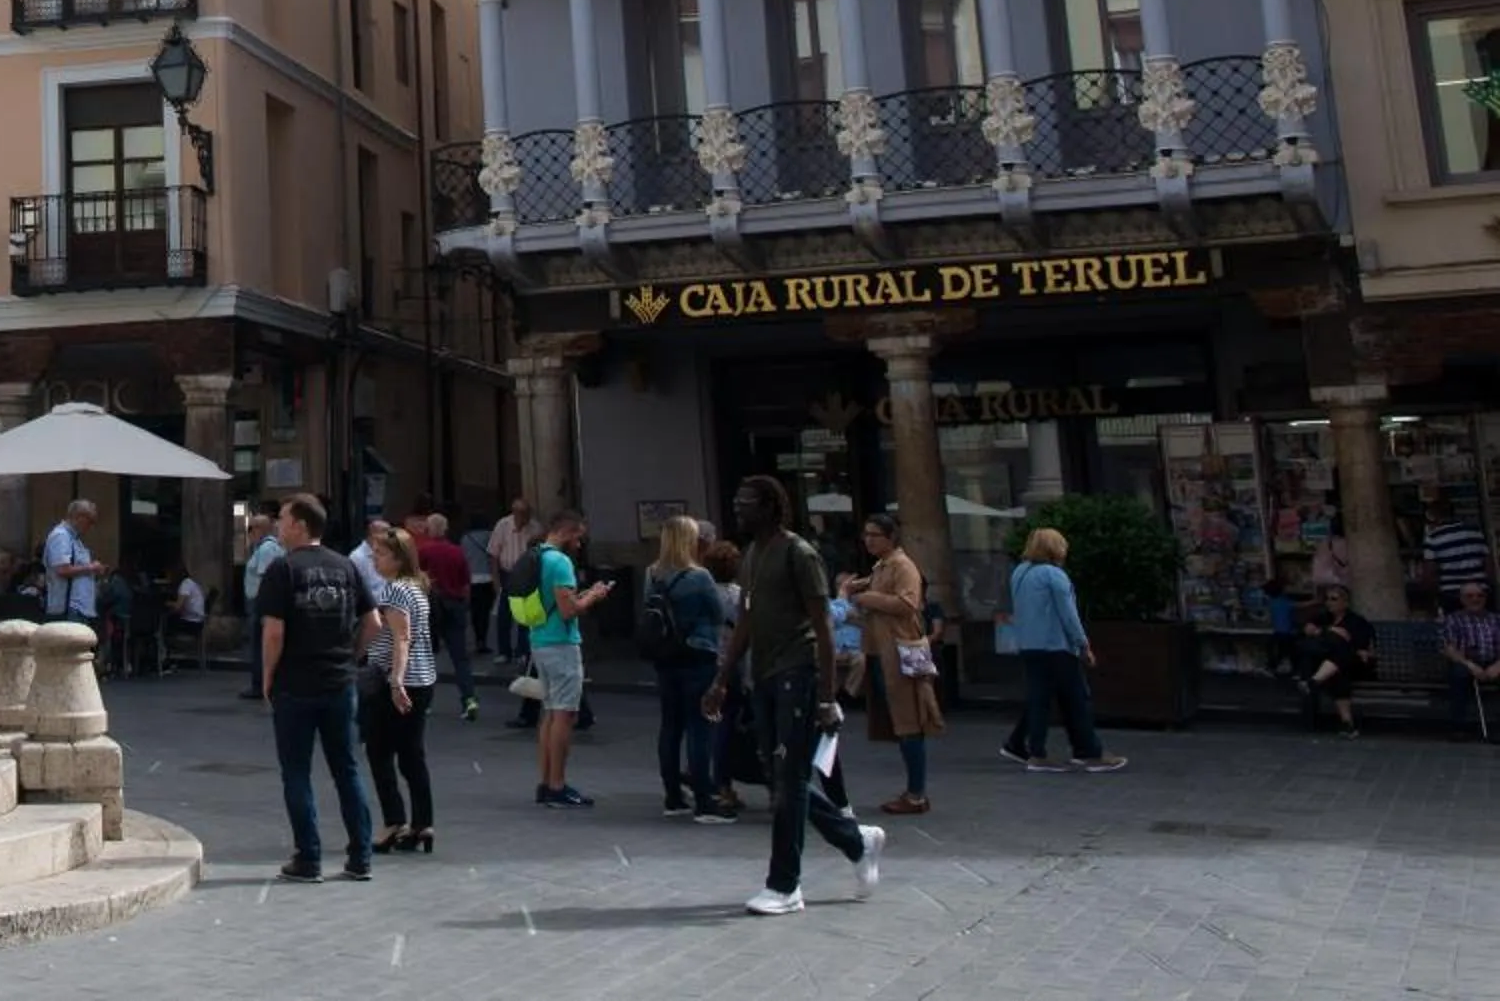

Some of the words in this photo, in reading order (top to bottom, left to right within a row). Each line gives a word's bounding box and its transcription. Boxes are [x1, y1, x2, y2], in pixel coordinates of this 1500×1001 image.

[679, 281, 777, 318] CAJA
[784, 270, 932, 311] RURAL
[939, 263, 1000, 299] DE
[1010, 249, 1207, 296] TERUEL
[875, 395, 970, 425] CA
[979, 384, 1120, 420] RURAL
